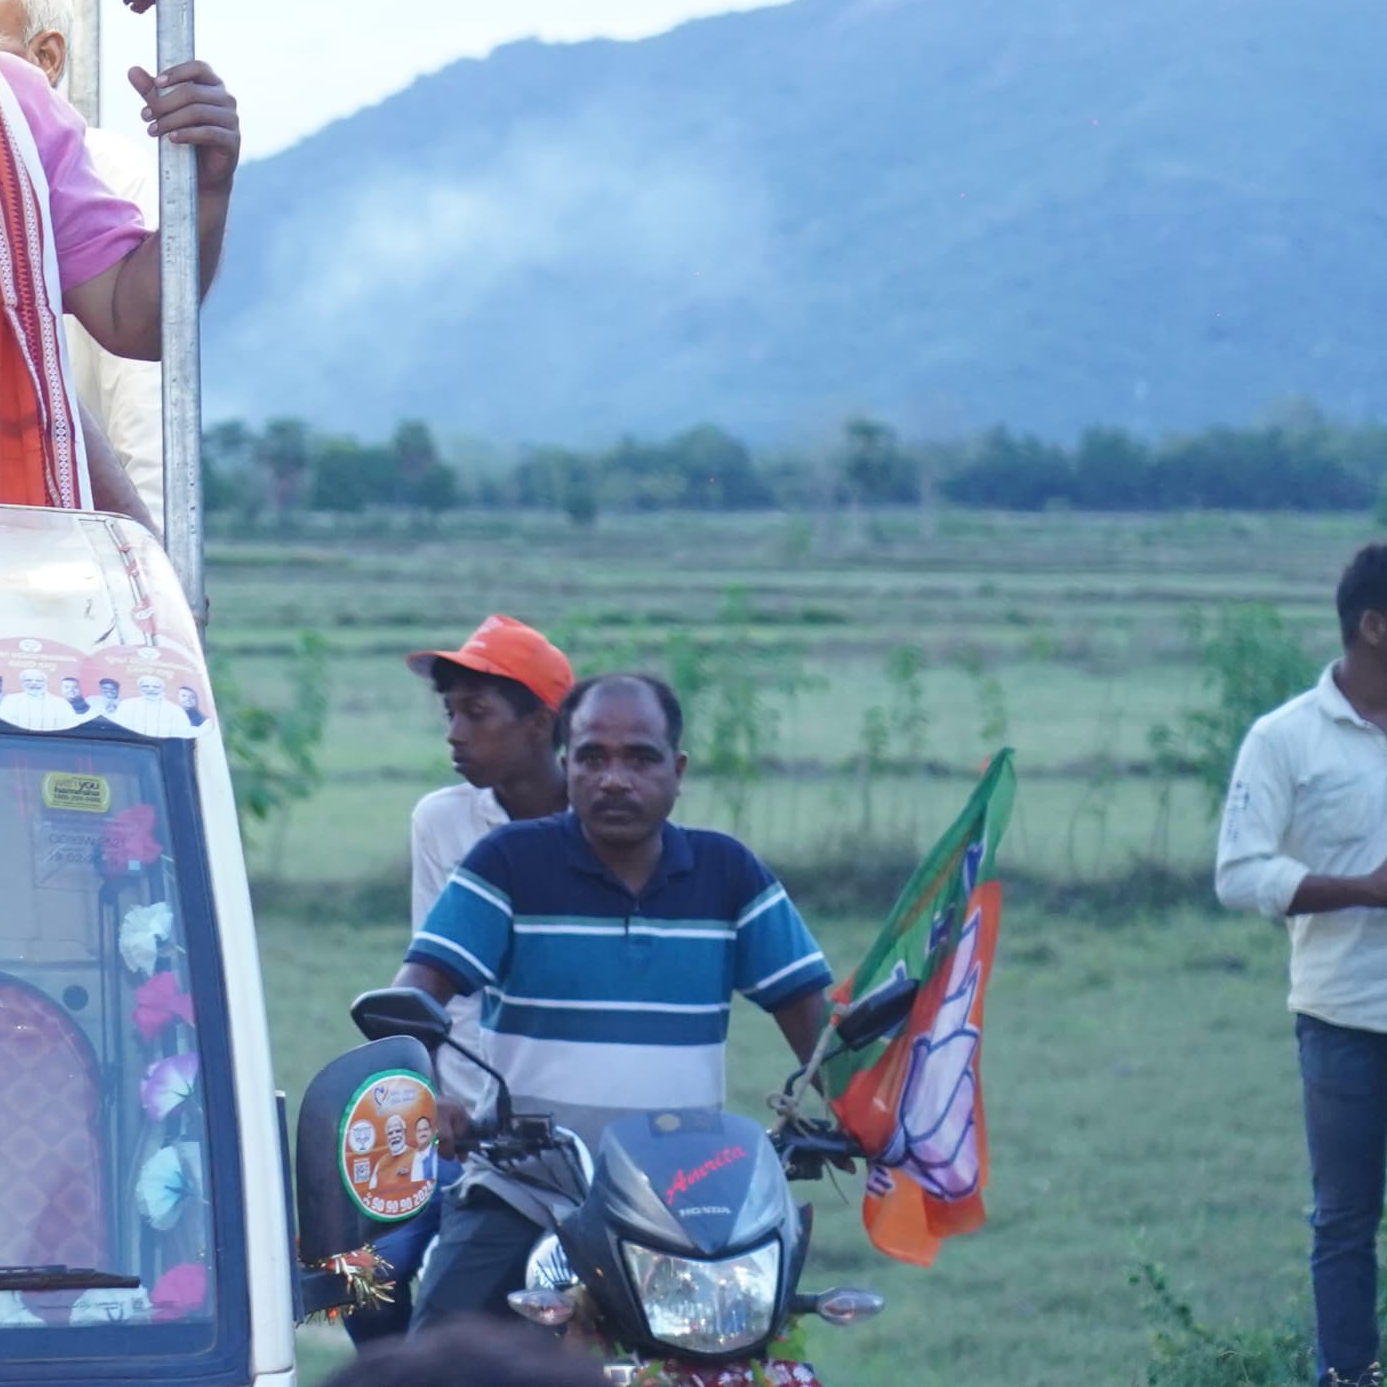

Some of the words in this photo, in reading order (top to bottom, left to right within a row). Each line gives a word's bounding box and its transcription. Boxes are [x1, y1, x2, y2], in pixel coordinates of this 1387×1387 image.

[78, 781, 100, 791] you
[666, 1144, 747, 1206] Amrita
[371, 1196, 385, 1212] 90
[386, 1200, 399, 1213] 90
[399, 1197, 413, 1212] 90
[679, 1205, 731, 1217] HONDA
